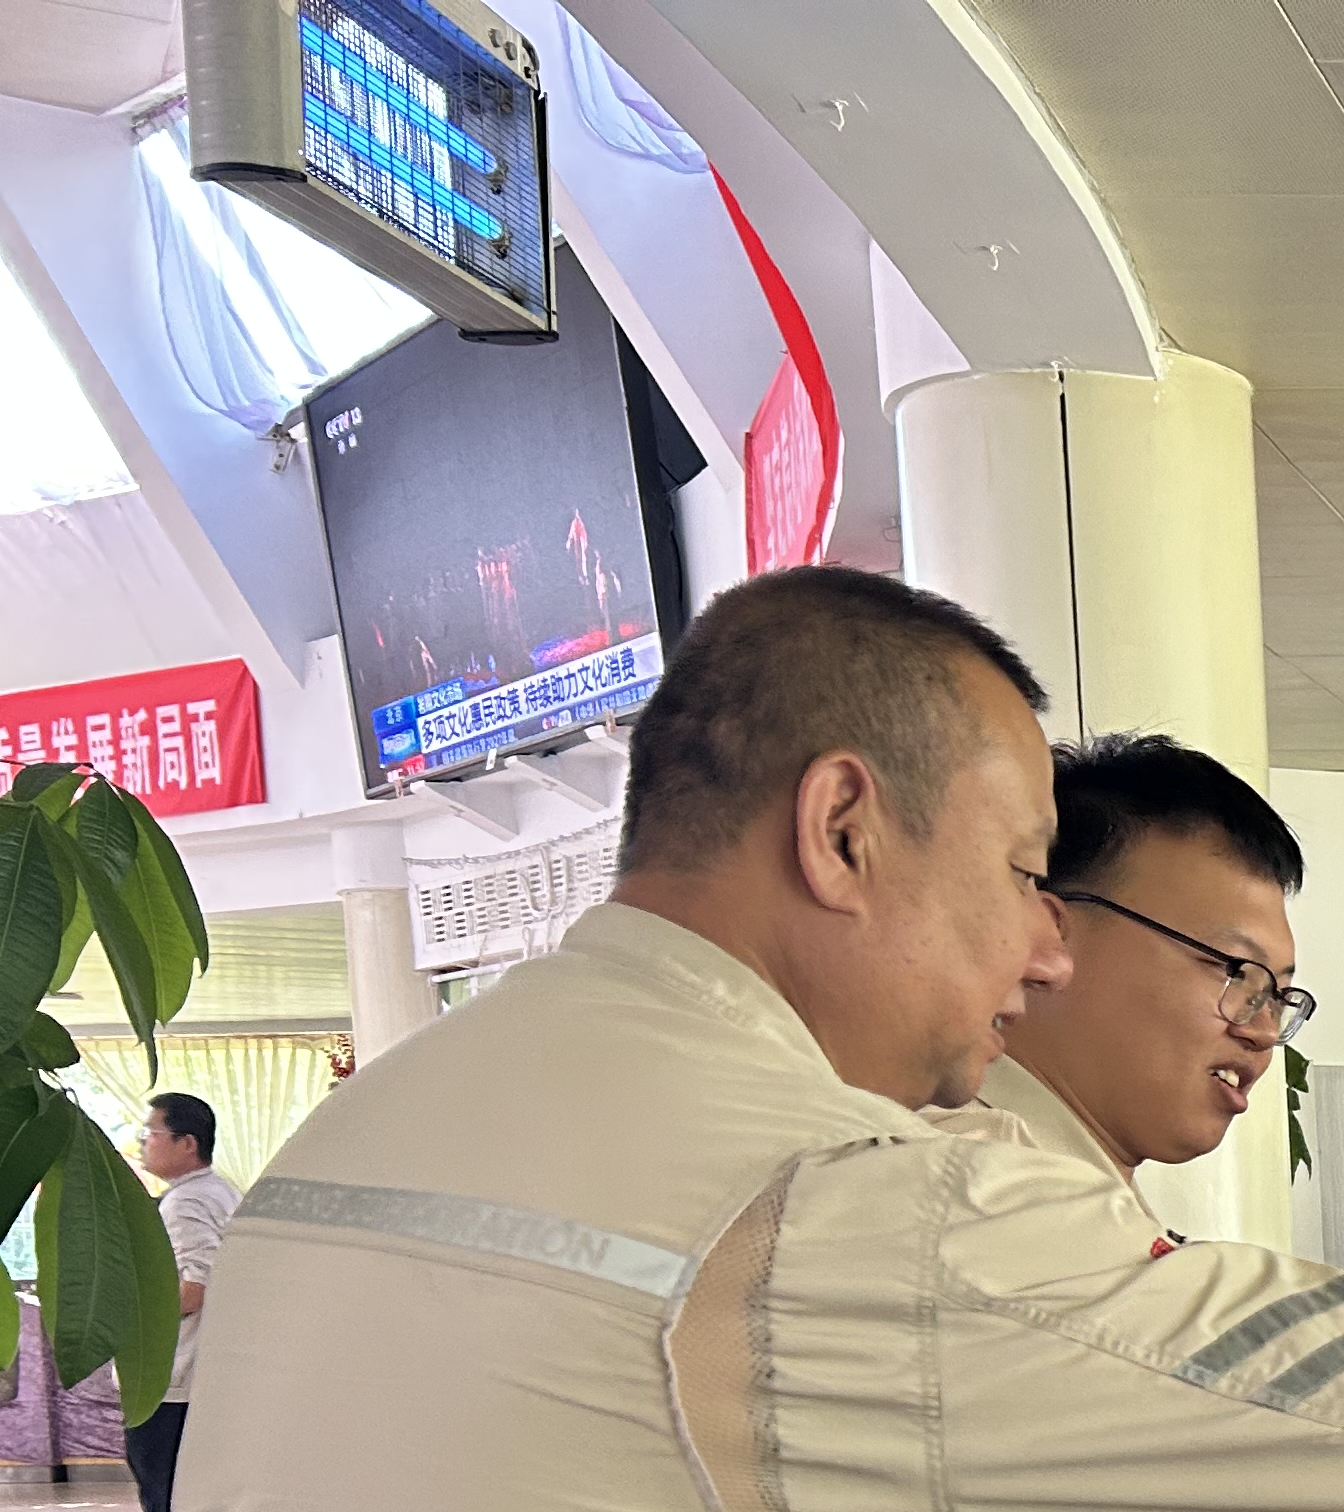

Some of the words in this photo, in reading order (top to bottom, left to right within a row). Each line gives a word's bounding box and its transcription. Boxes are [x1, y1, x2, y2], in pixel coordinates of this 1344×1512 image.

[422, 687, 522, 750] 多项文化惠民政策
[523, 647, 637, 712] 持续助力文化消费
